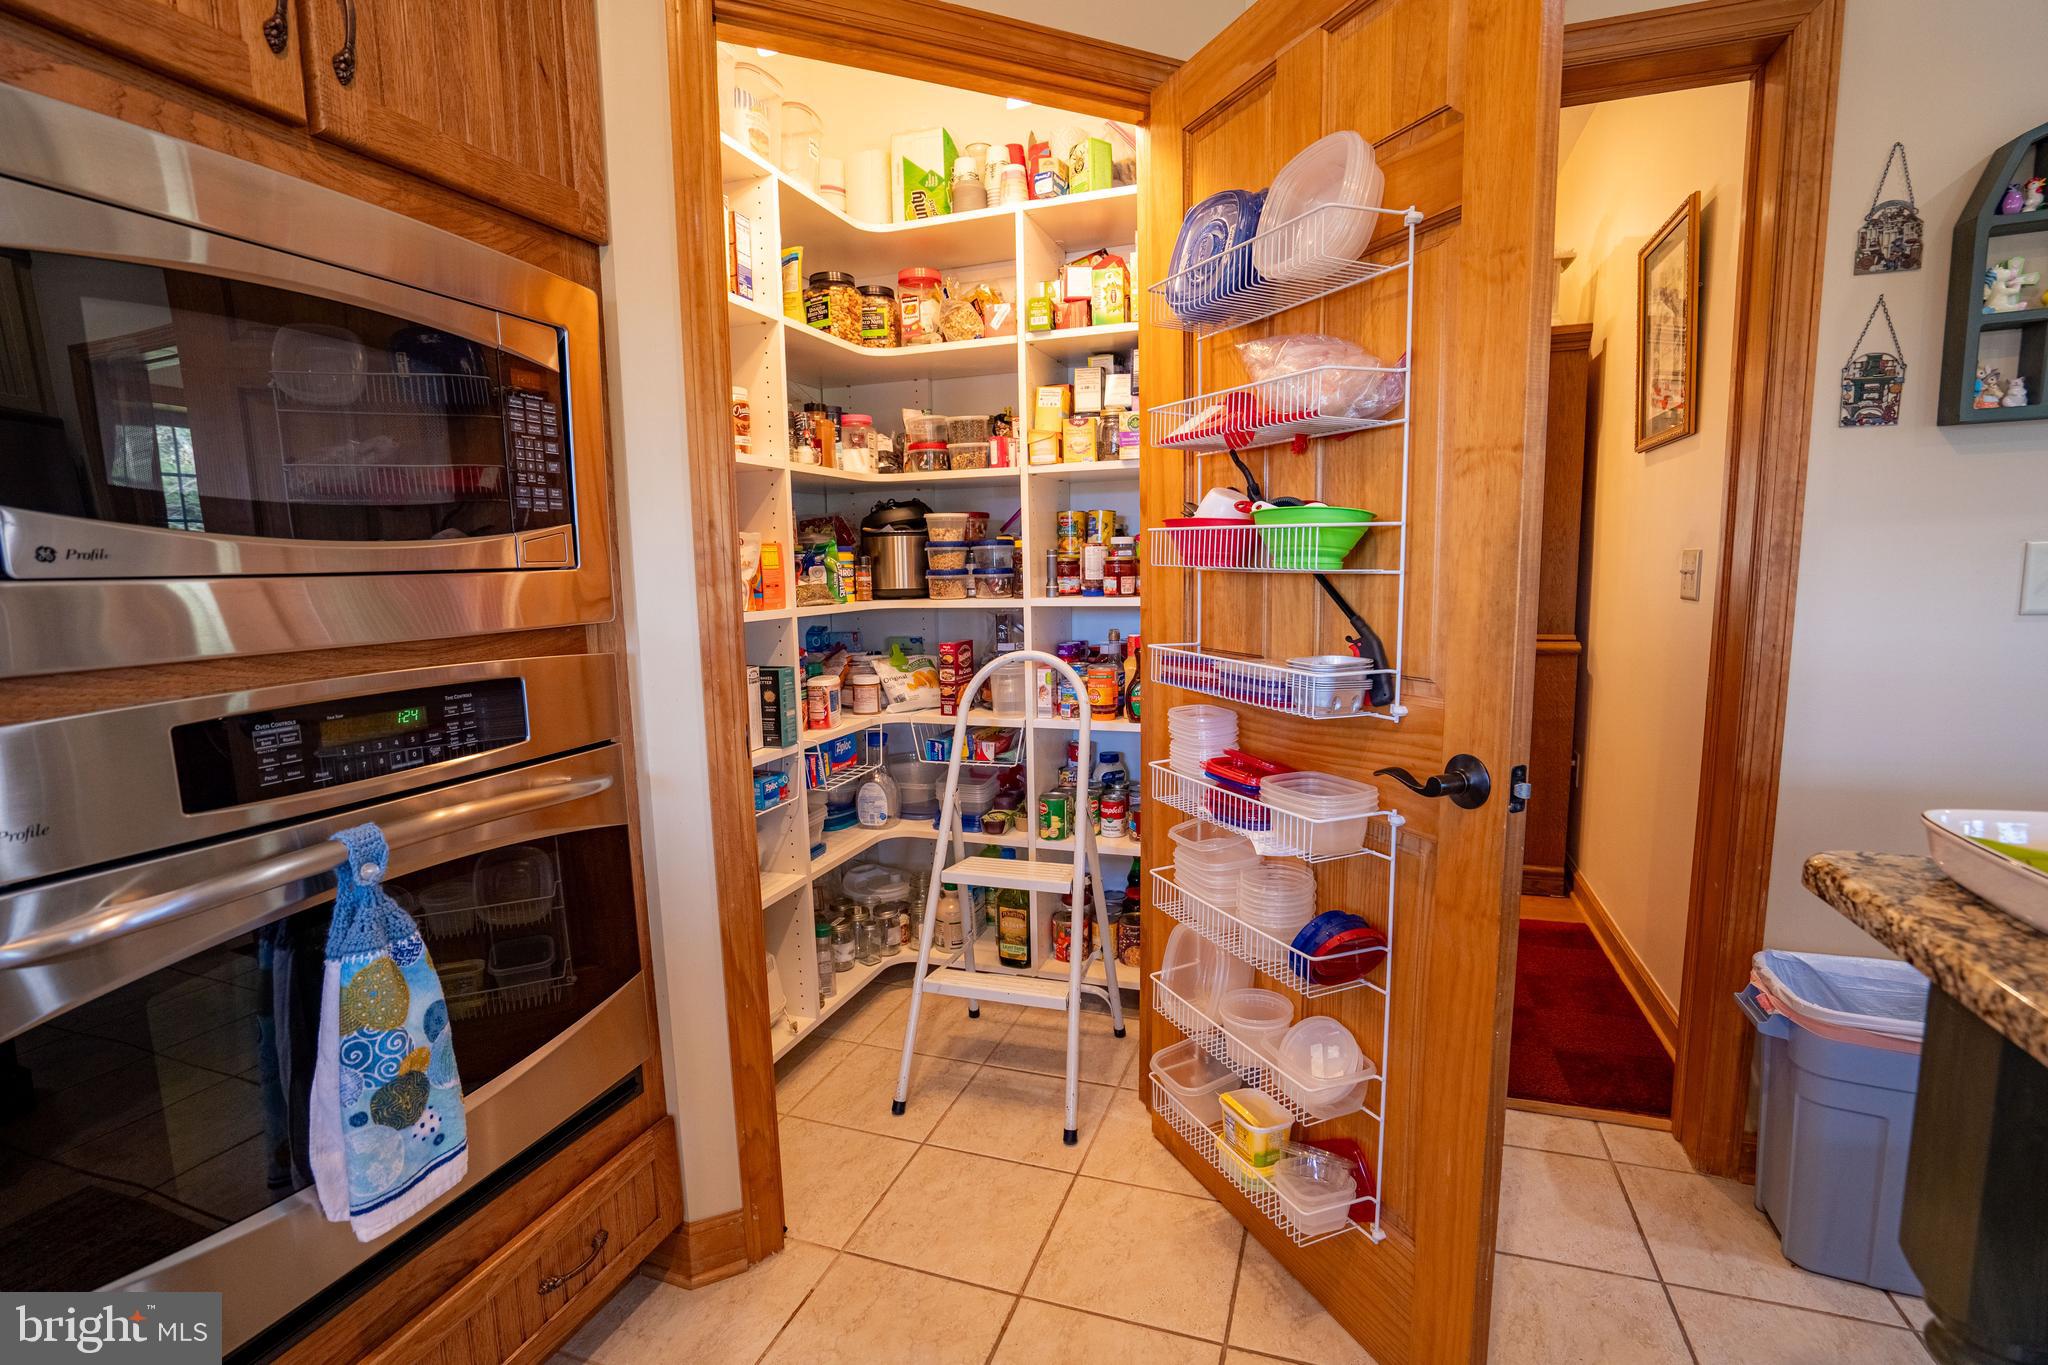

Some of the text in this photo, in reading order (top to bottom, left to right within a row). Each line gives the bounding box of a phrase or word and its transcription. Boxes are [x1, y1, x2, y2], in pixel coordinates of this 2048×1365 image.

[883, 674, 908, 683] Original
[397, 709, 419, 723] 1:24
[270, 720, 296, 729] CONTROLS
[835, 741, 852, 754] Ziploc
